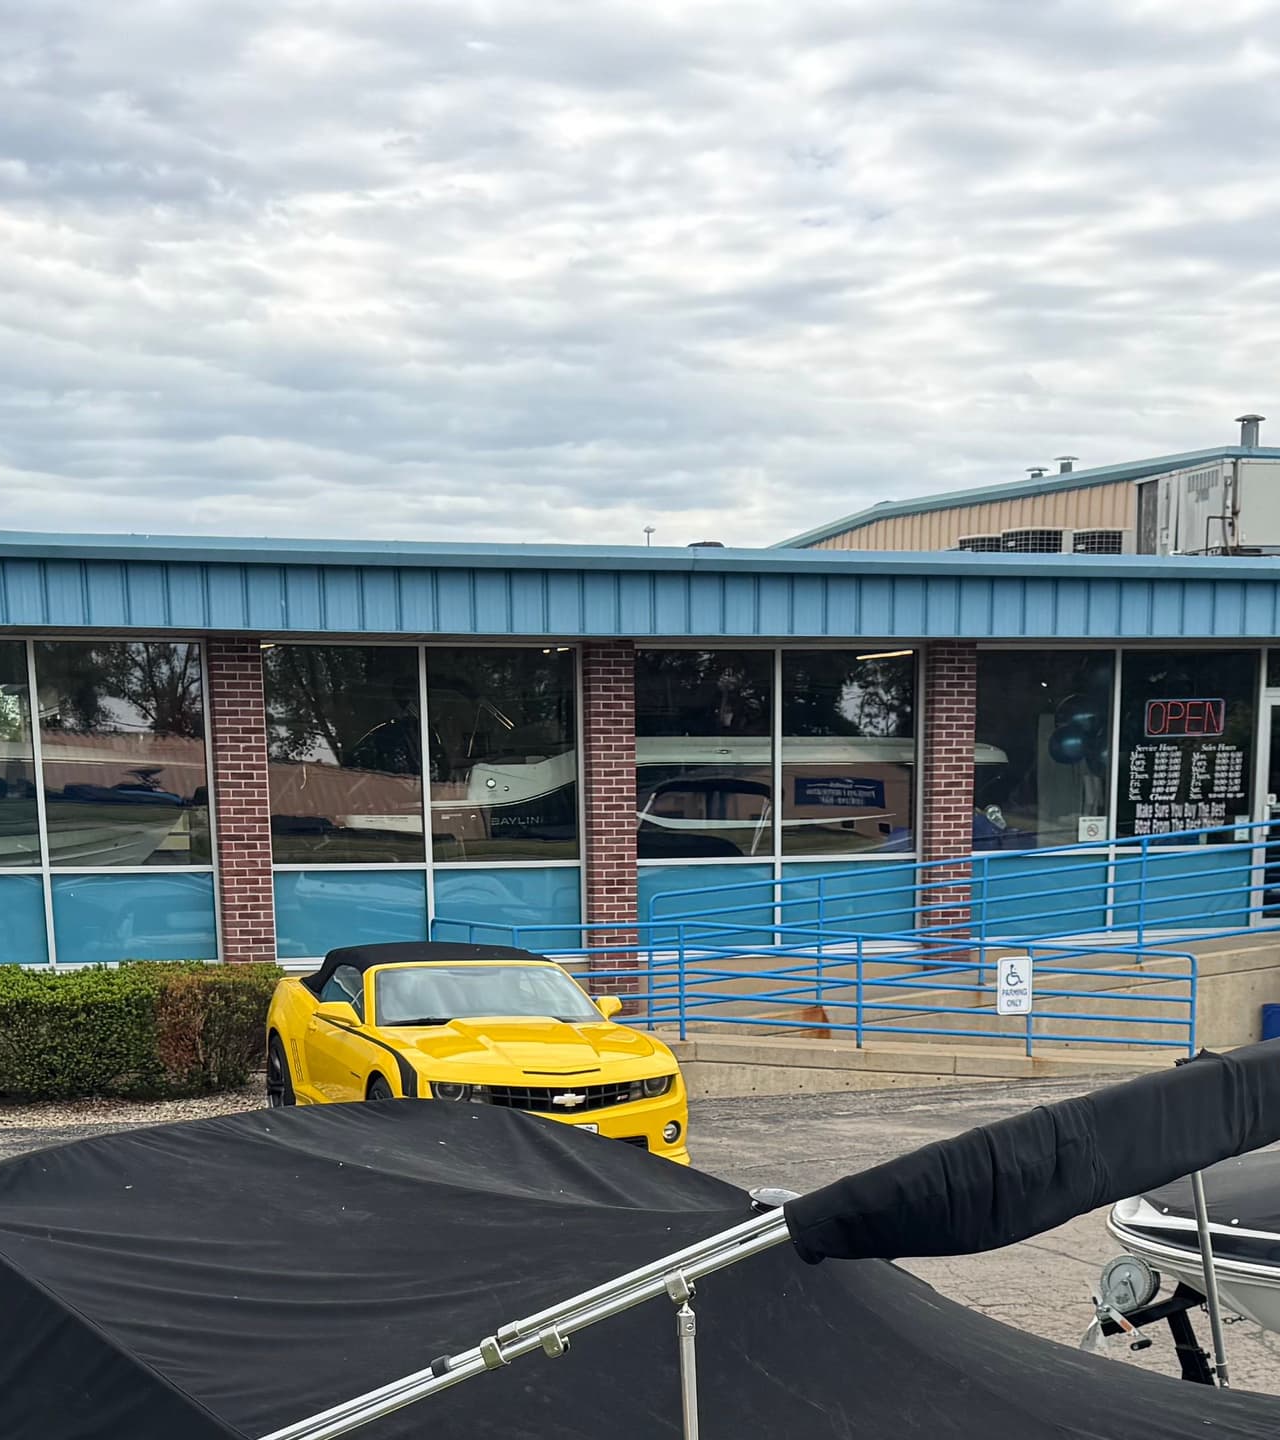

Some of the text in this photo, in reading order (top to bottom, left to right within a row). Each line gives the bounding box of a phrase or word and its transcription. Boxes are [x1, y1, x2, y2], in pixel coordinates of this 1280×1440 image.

[1148, 701, 1224, 735] OPEN
[1136, 801, 1226, 819] Make Sure You Buy The Best
